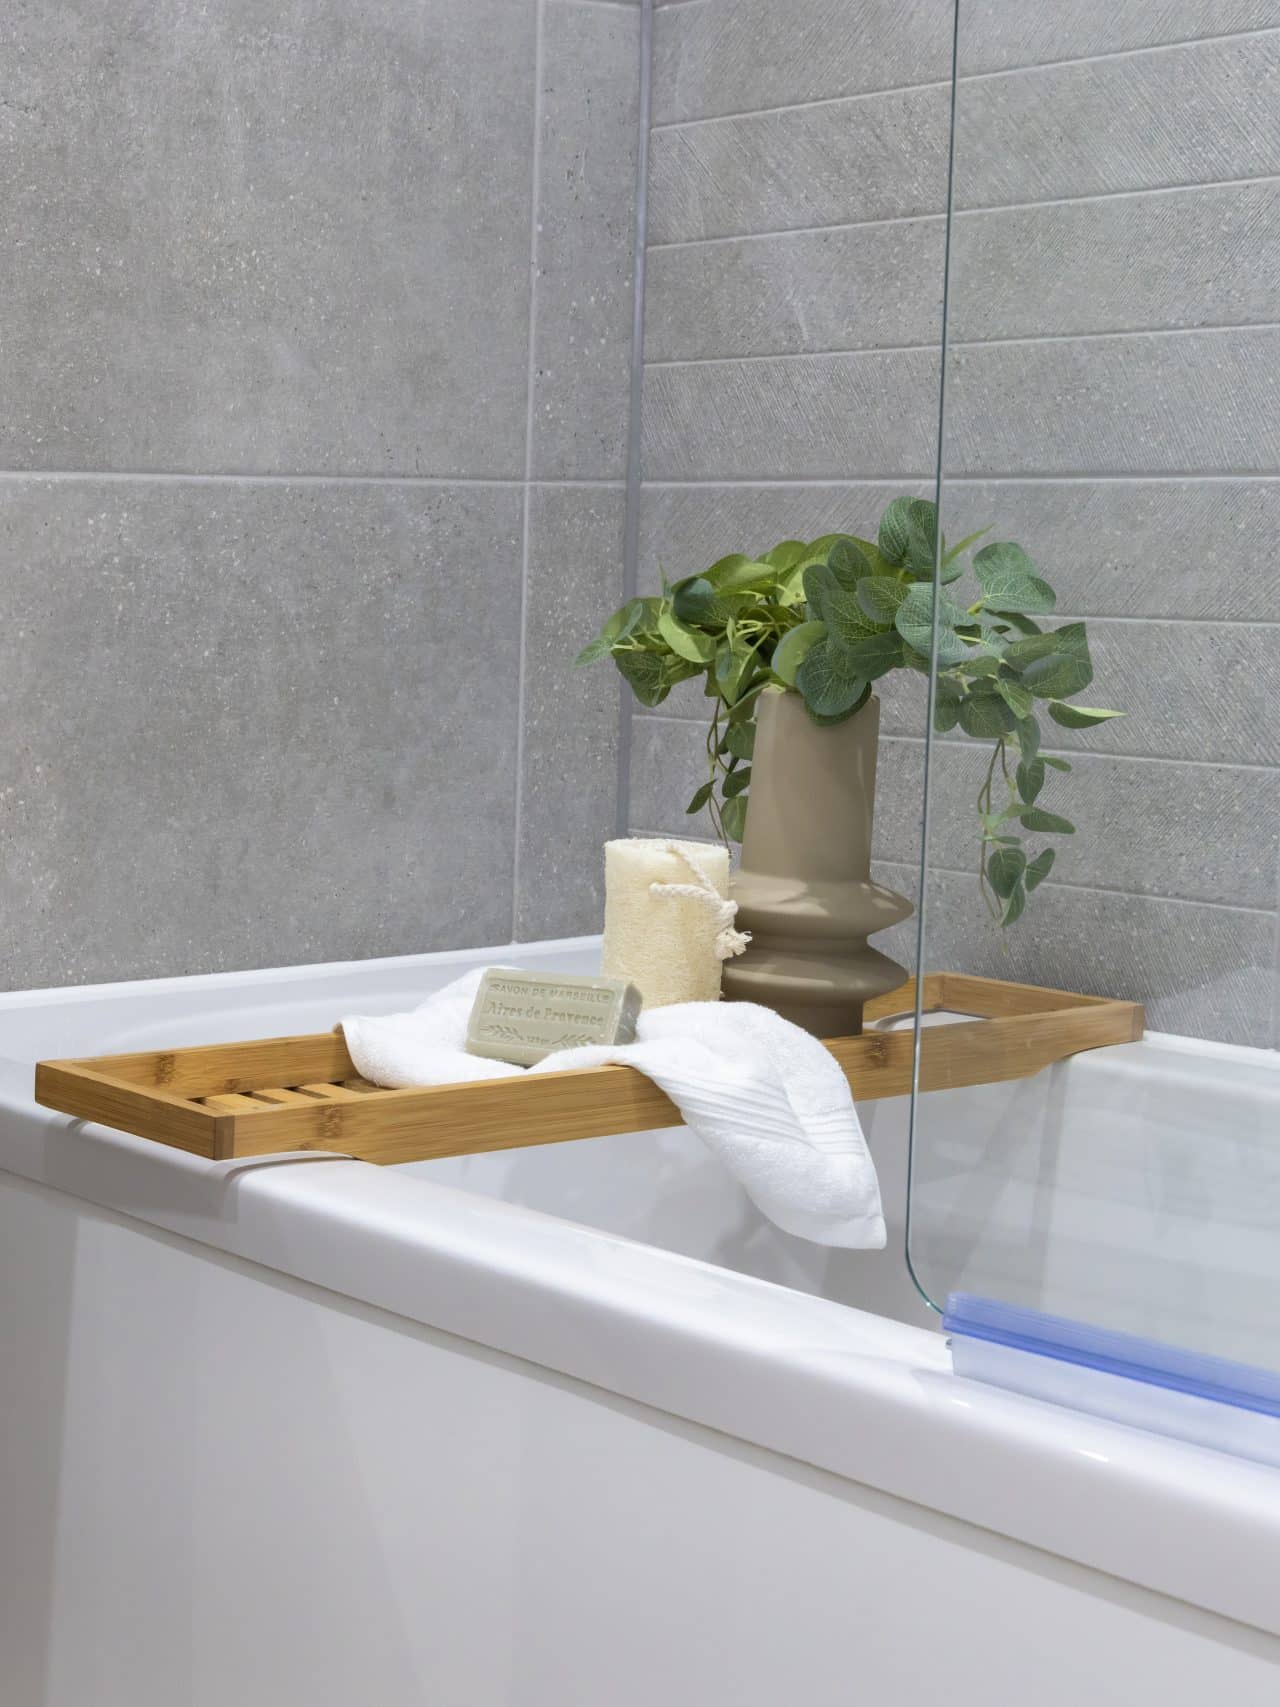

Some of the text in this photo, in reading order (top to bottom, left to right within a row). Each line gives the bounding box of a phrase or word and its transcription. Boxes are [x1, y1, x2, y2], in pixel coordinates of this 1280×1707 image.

[489, 983, 528, 996] SAVON
[532, 987, 545, 997] DE
[526, 1005, 541, 1019] de
[543, 1007, 604, 1026] Provence
